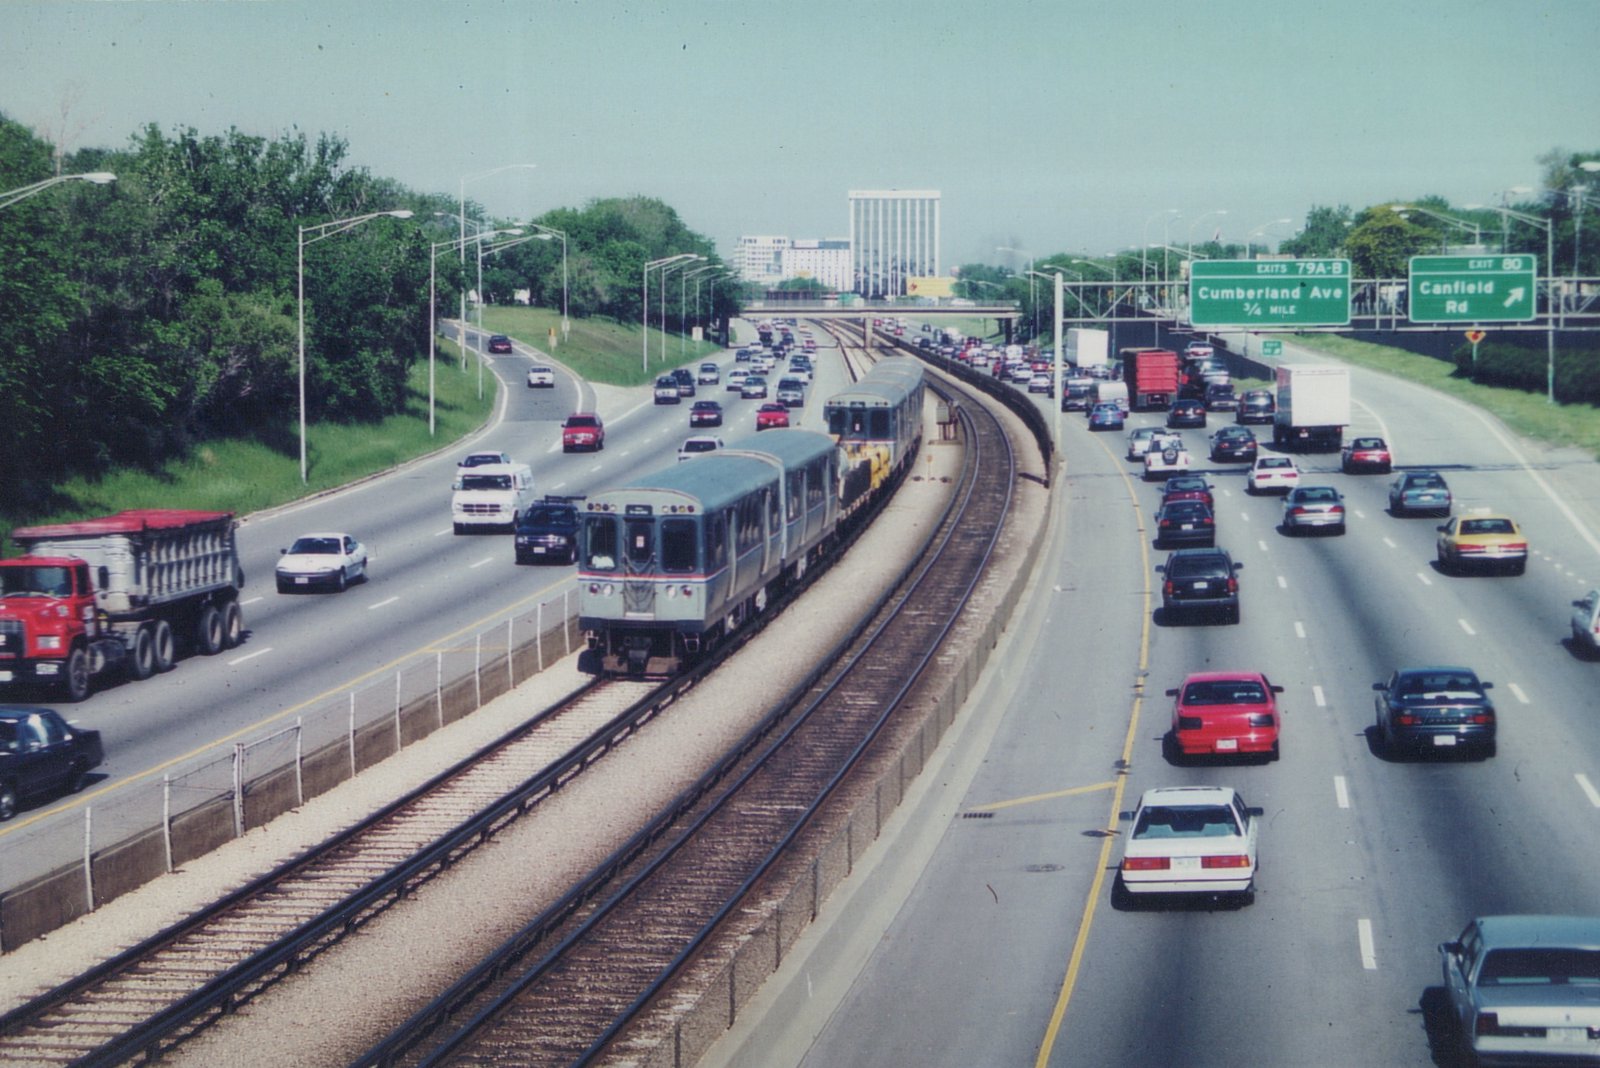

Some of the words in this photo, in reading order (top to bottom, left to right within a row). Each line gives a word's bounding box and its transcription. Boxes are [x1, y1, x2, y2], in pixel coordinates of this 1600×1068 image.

[1256, 264, 1287, 273] EXITS
[1296, 262, 1343, 274] 79A-B
[1468, 259, 1494, 269] EXIT
[1502, 258, 1523, 270] 80
[1197, 286, 1301, 300] Cumberland
[1310, 287, 1343, 299] Ave
[1419, 281, 1494, 295] Canfield
[1269, 305, 1296, 315] MILE
[1445, 300, 1468, 313] Rd
